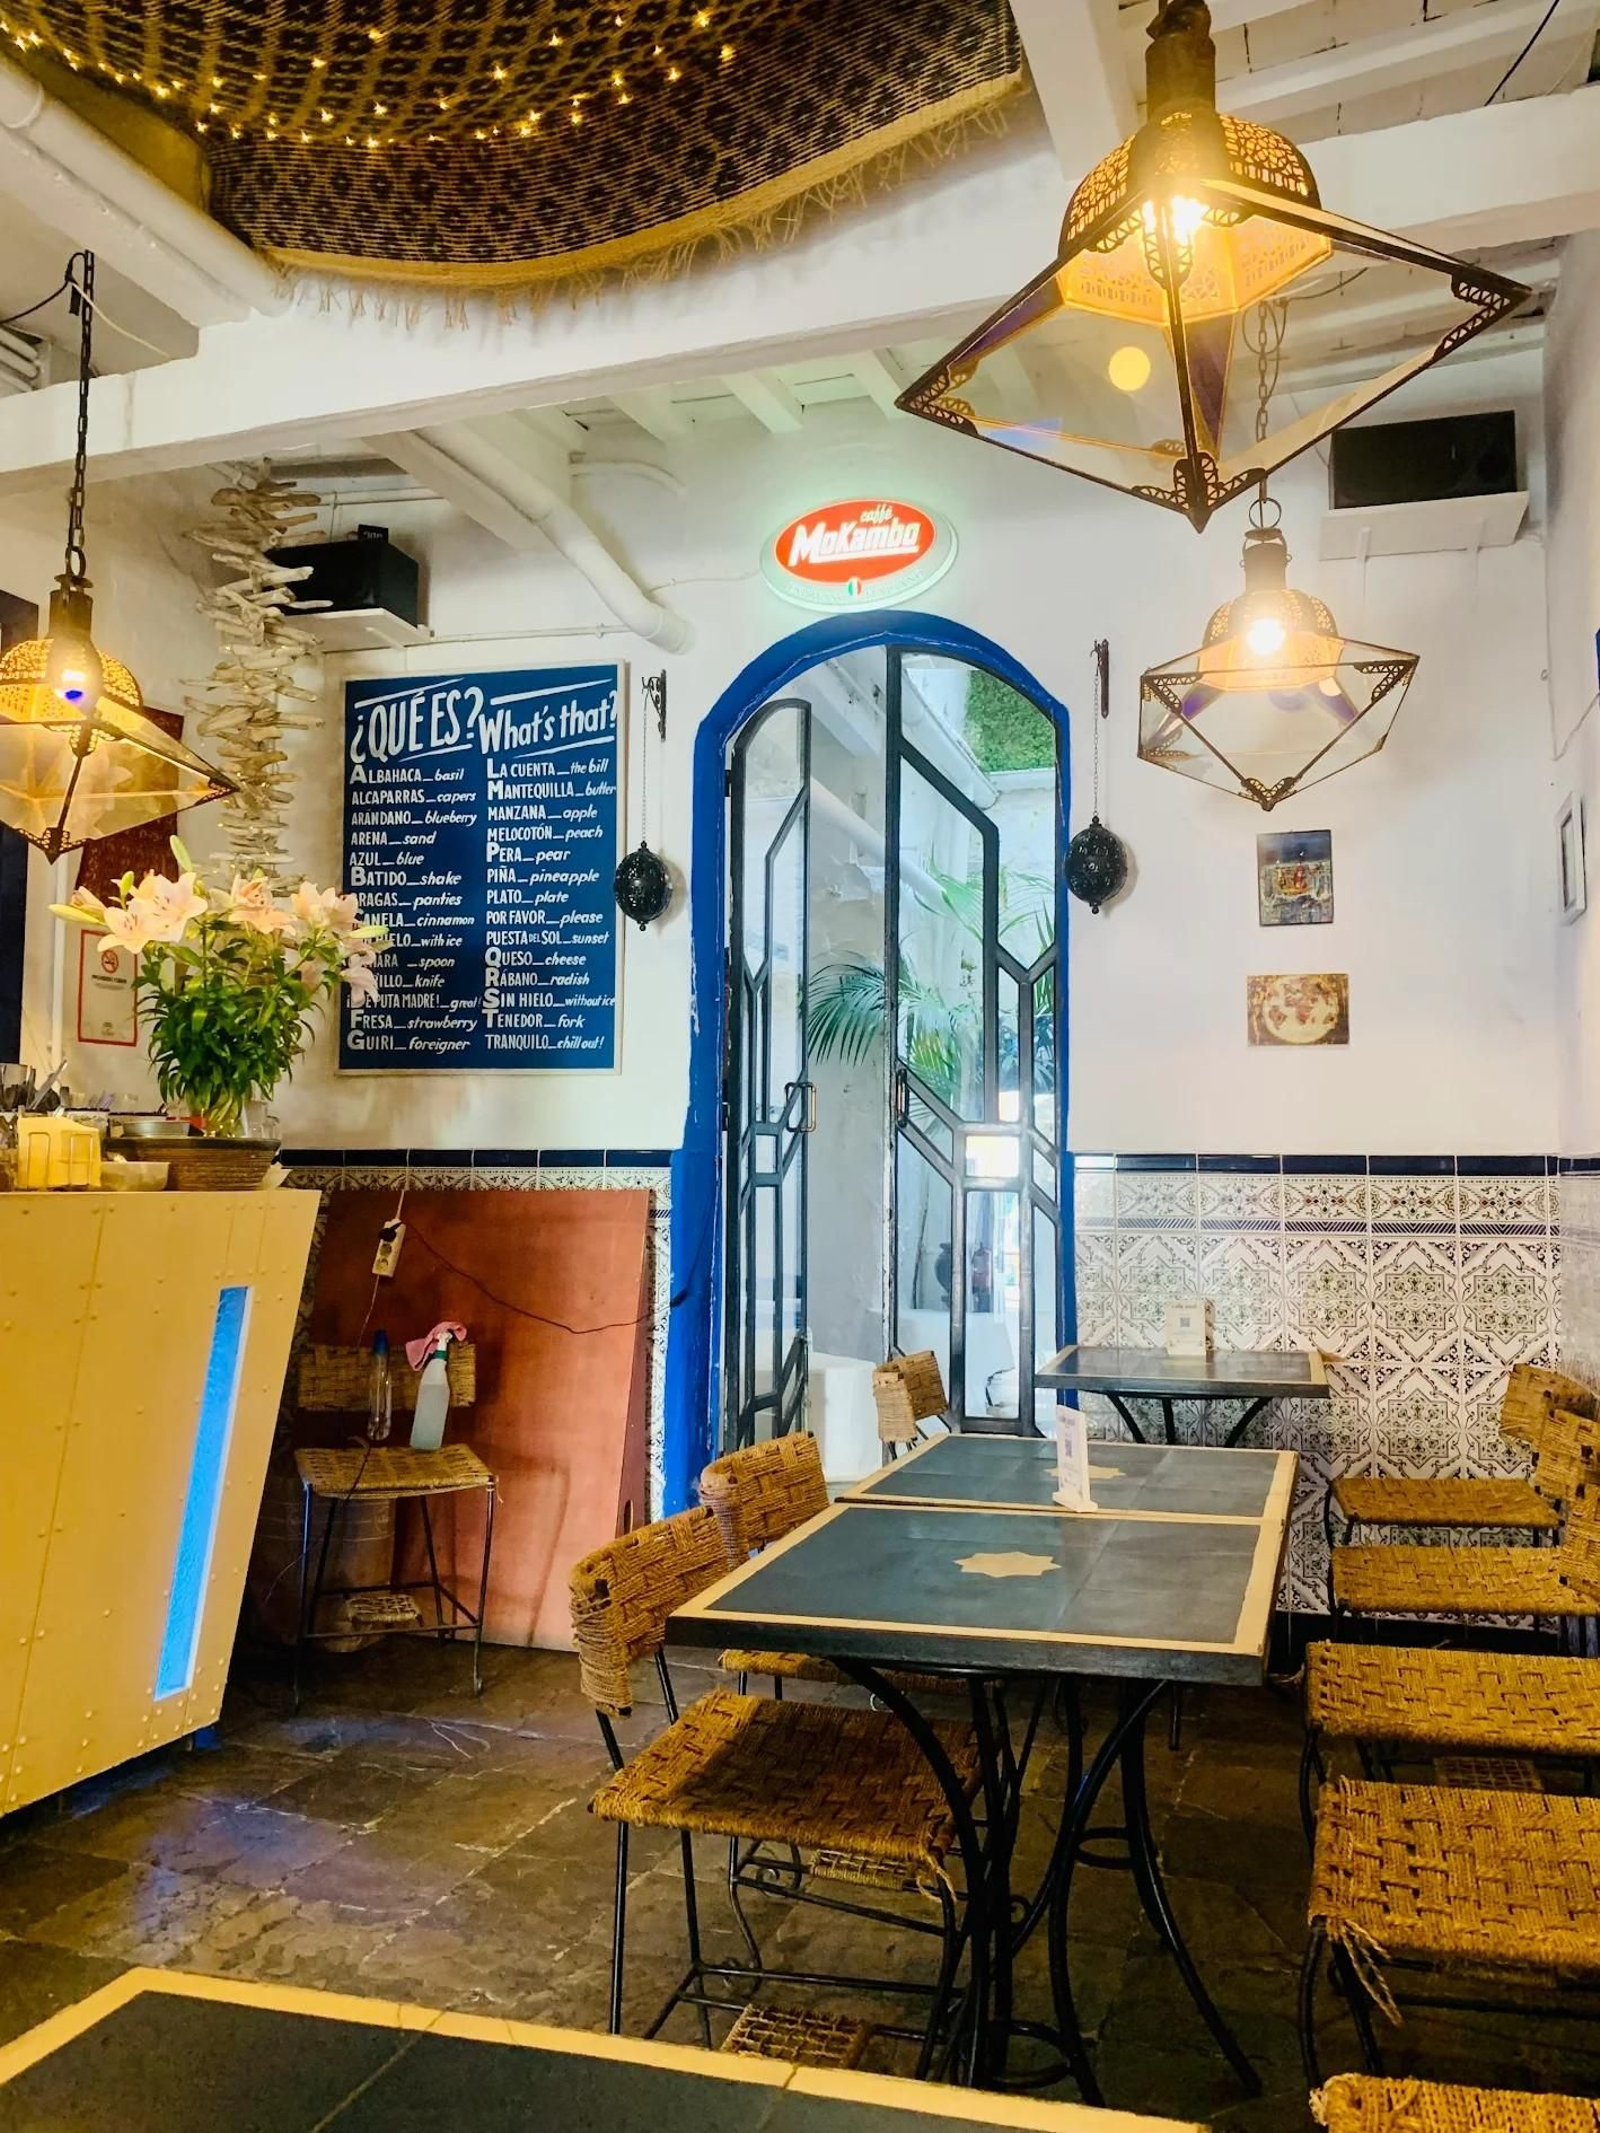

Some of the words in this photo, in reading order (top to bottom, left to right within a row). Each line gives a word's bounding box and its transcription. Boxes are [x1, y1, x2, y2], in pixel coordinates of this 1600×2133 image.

[350, 691, 425, 763] ¿QUÉ
[430, 686, 484, 747] ES?
[479, 705, 555, 754] What's
[560, 690, 617, 738] that?
[350, 764, 422, 784] ALBAHACA
[434, 768, 465, 781] basil
[487, 758, 508, 779] LA
[510, 762, 555, 777] CUENTA
[570, 762, 587, 774] the
[588, 758, 609, 773] bill
[351, 789, 425, 805] ALCAPARRAS
[437, 792, 476, 804] capers
[487, 780, 574, 800] MANTEQUILLA
[585, 781, 616, 796] butter
[425, 810, 477, 827] blueberry
[487, 805, 546, 821] MANZANA
[563, 804, 598, 822] apple
[351, 831, 388, 845] ARENA
[402, 830, 437, 844] sand
[487, 823, 552, 842] MELOCOTÓN
[565, 825, 604, 842] peach
[349, 852, 381, 866] AZUL
[396, 851, 425, 865] blue
[486, 842, 522, 862] PERA
[536, 850, 571, 865] pear
[351, 866, 407, 886] BATIDO
[420, 870, 462, 885] shake
[487, 865, 516, 883] PIÑA
[529, 868, 600, 886] pineapple
[413, 892, 463, 911] panties
[486, 889, 522, 904] PLATO
[534, 890, 569, 906] plate
[358, 909, 404, 927] ANELA
[416, 913, 475, 927] cinnamon
[486, 910, 507, 925] POR
[509, 910, 546, 925] FAVOR
[559, 910, 604, 929] please
[420, 933, 443, 947] with
[445, 934, 463, 947] ice
[486, 931, 528, 945] PUESTA
[541, 930, 563, 945] SOL
[571, 931, 610, 944] sunset
[419, 958, 455, 971] spoon
[484, 946, 533, 968] QUESO
[545, 951, 587, 966] cheese
[415, 974, 445, 988] knife
[485, 967, 538, 987] RÁBANO
[549, 971, 590, 986] radish
[482, 987, 515, 1009] SIN
[519, 992, 553, 1007] HIELO
[564, 993, 602, 1007] without
[350, 1009, 393, 1029] FRESA
[407, 1015, 478, 1032] strawberry
[482, 1009, 543, 1028] TENEDOR
[557, 1014, 586, 1028] fork
[346, 1029, 394, 1050] GUIRI
[408, 1036, 471, 1055] foreigner
[485, 1034, 548, 1051] TRANQUILO
[557, 1036, 581, 1049] chill
[581, 1036, 605, 1049] out!
